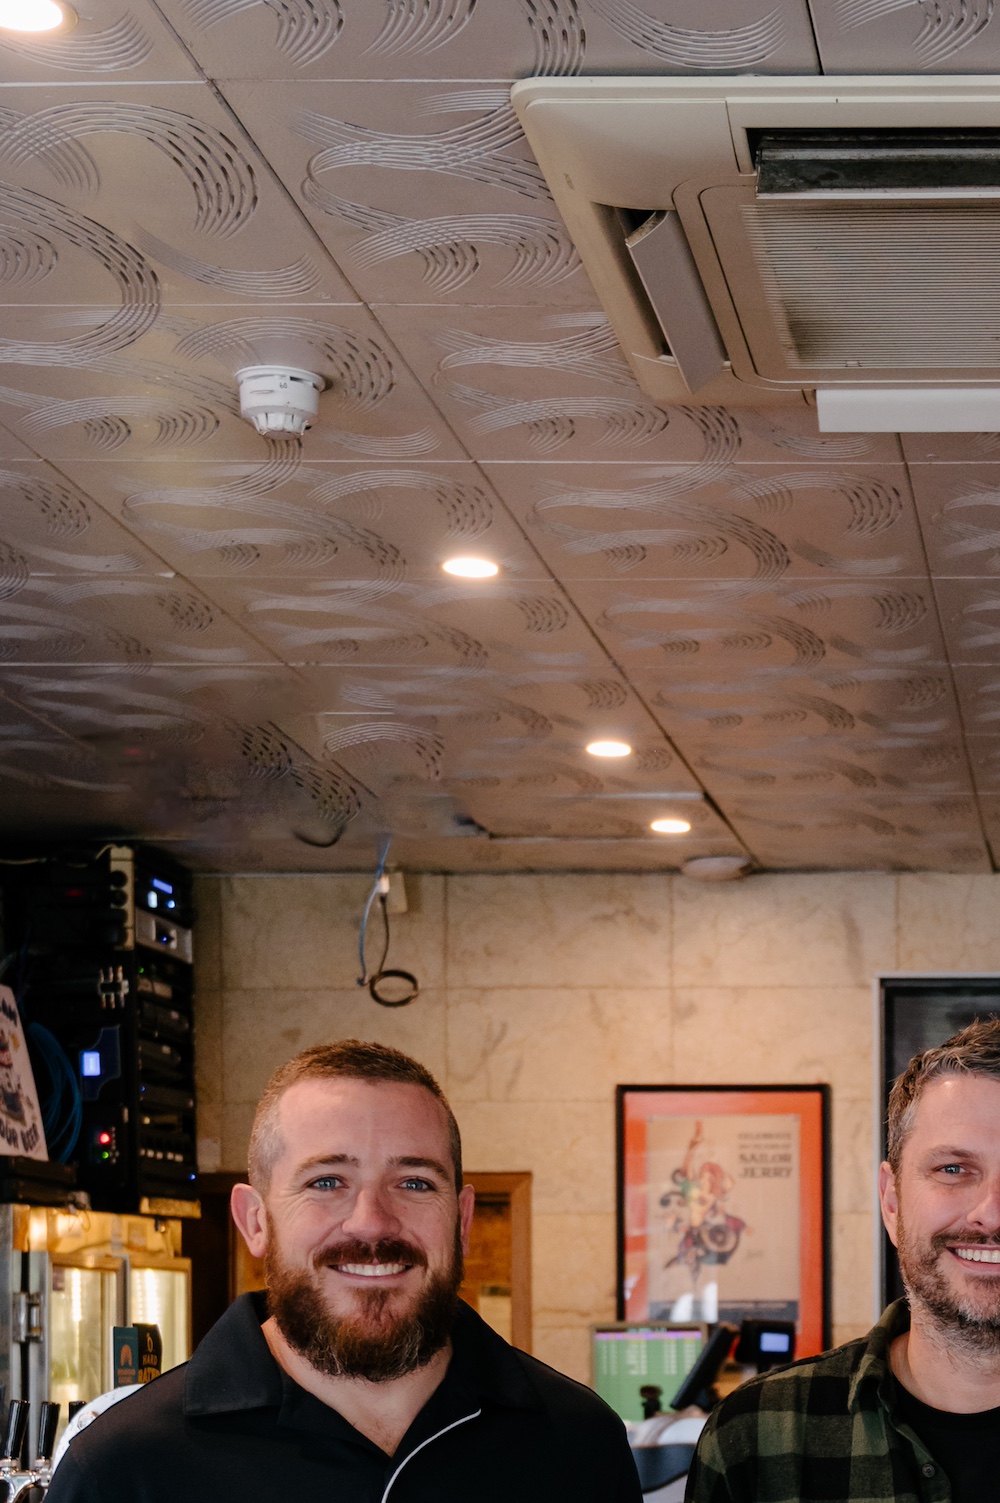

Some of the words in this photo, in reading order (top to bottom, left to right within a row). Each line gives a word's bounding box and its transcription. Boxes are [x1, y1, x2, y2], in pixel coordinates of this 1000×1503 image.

[738, 1152, 792, 1164] SAILOR
[738, 1167, 793, 1178] JERRY
[142, 1353, 158, 1366] HARD
